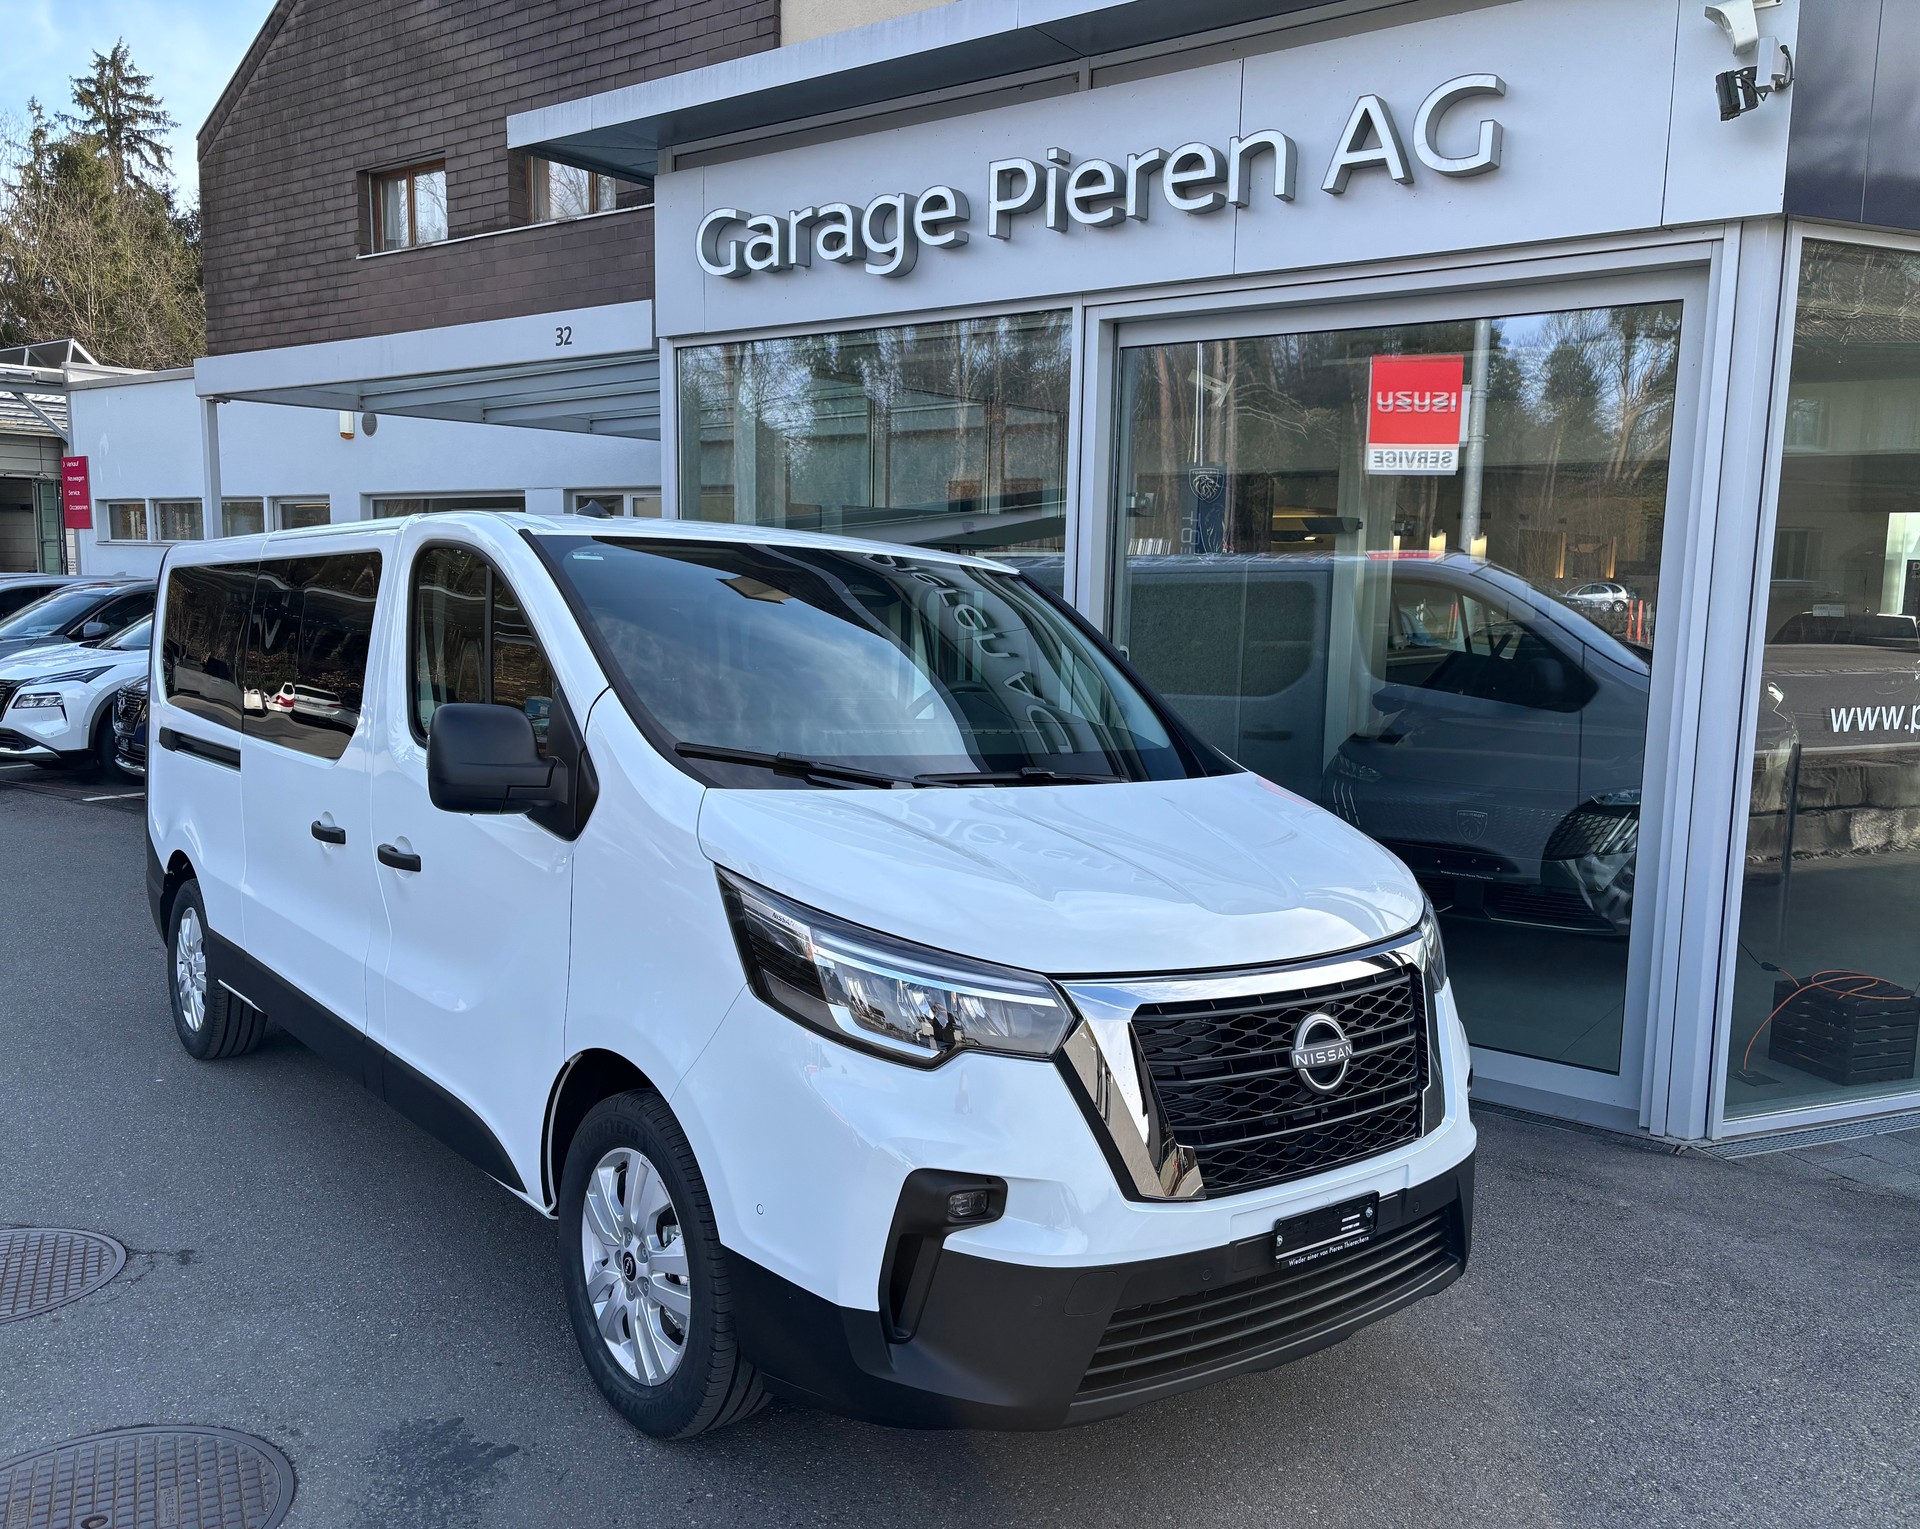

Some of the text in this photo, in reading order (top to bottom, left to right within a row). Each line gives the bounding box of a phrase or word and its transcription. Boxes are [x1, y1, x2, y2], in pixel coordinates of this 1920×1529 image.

[695, 73, 1506, 279] Garage Pieren AG
[555, 326, 572, 346] 32
[1295, 1044, 1353, 1066] NISSAN
